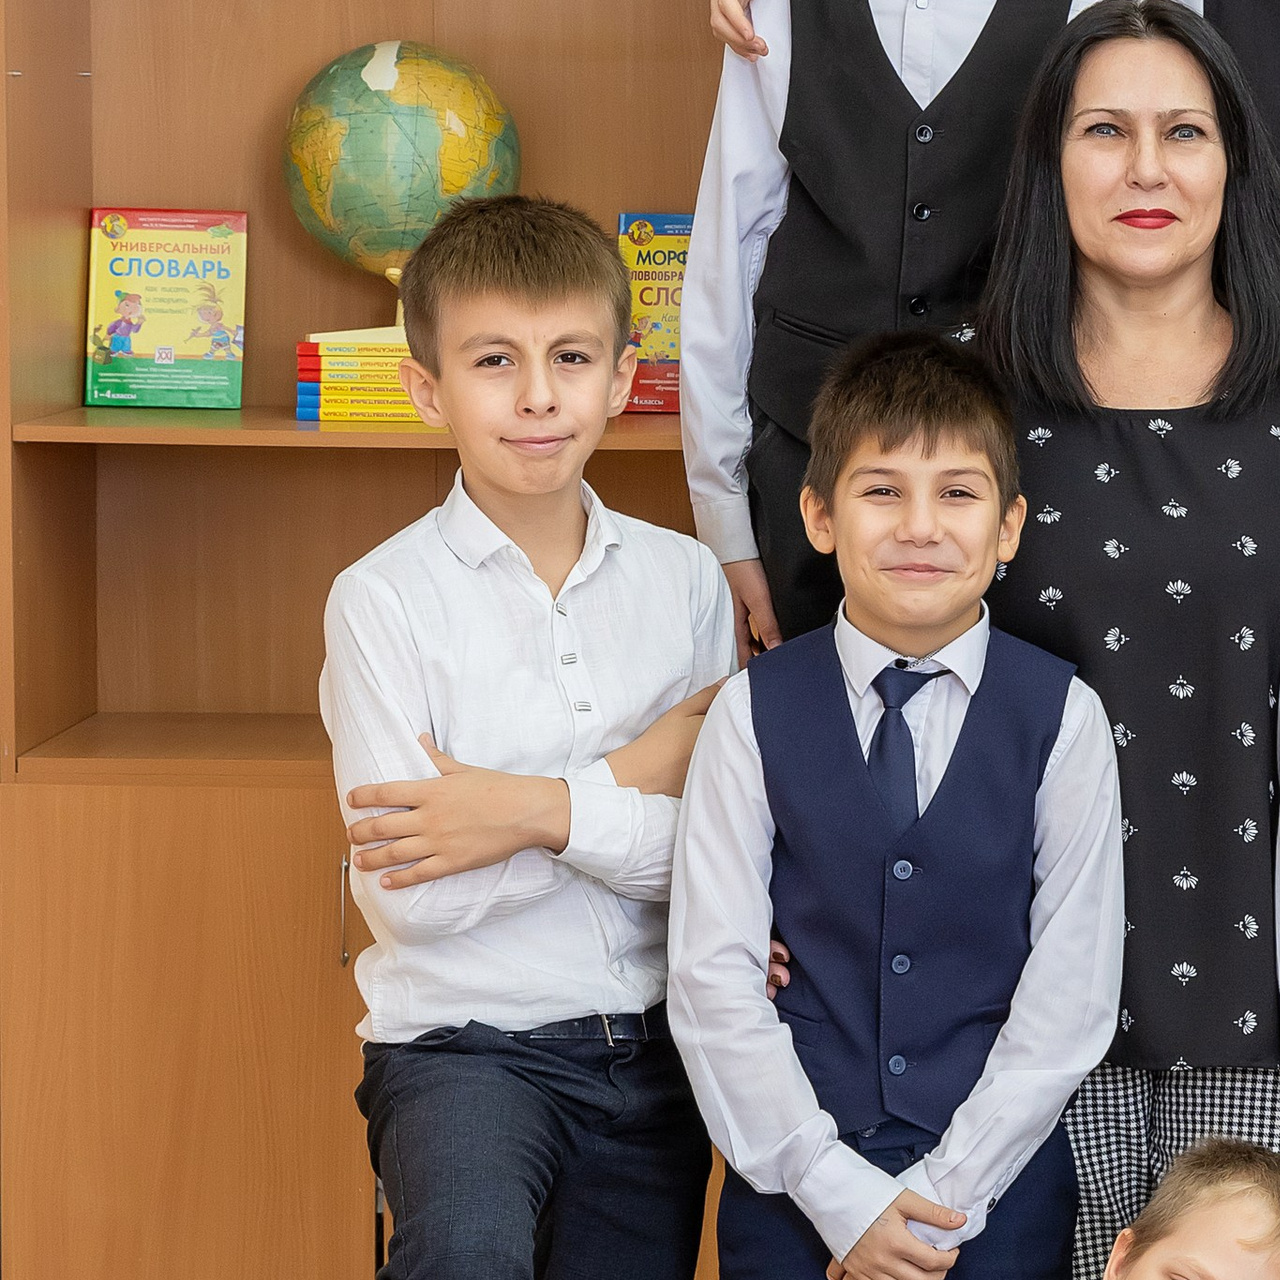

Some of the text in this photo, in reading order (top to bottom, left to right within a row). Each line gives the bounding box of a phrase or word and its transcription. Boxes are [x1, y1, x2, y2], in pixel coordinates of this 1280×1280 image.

[110, 241, 231, 255] УНИВЕРСАЛЬНЫЙ
[109, 257, 231, 279] СЛОВАРЬ
[631, 271, 684, 281] ЛОВООБРА
